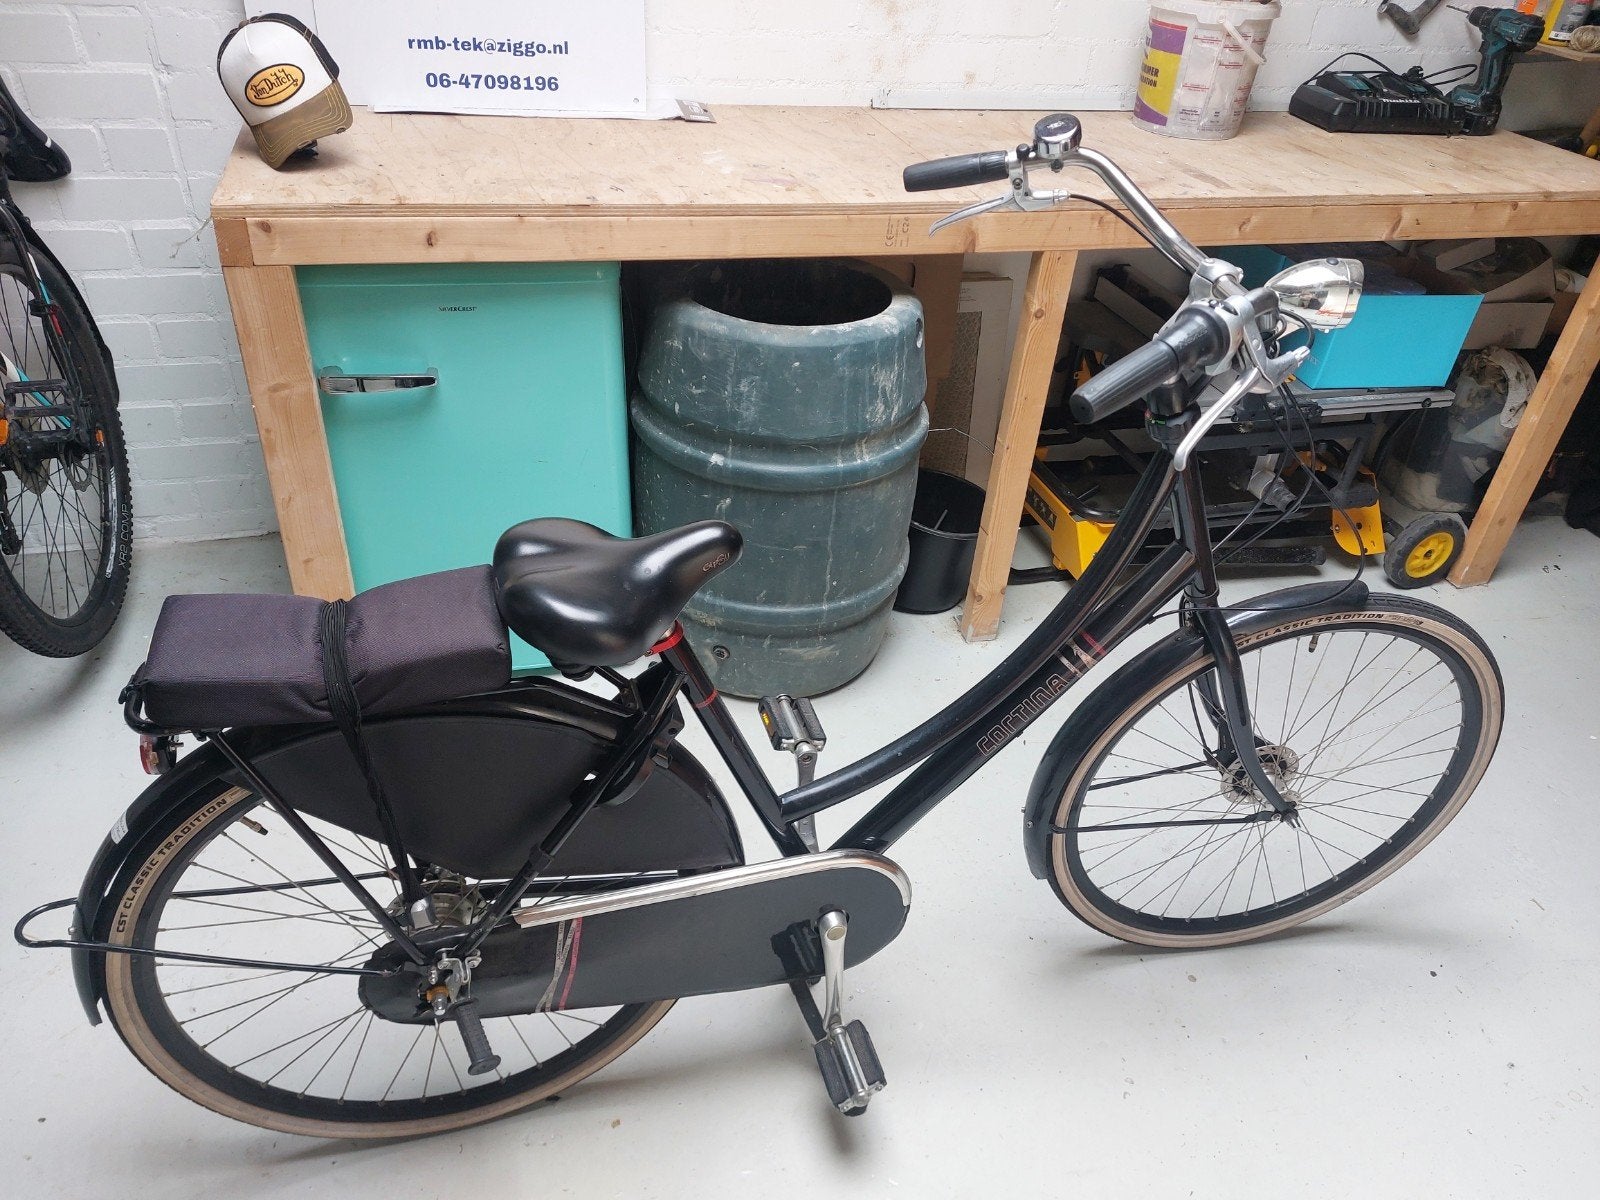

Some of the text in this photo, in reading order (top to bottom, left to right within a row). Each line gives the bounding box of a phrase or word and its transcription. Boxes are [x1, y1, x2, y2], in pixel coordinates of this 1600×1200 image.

[407, 36, 569, 58] rmb-tek@ziggo.nl
[263, 68, 296, 92] Dutch
[425, 72, 560, 92] 06-47098196
[118, 503, 130, 569] XR2 COMP
[1255, 620, 1315, 641] CLASSIC
[1317, 613, 1384, 624] TRADITION
[116, 798, 228, 933] CST CLASSIC TRADITION
